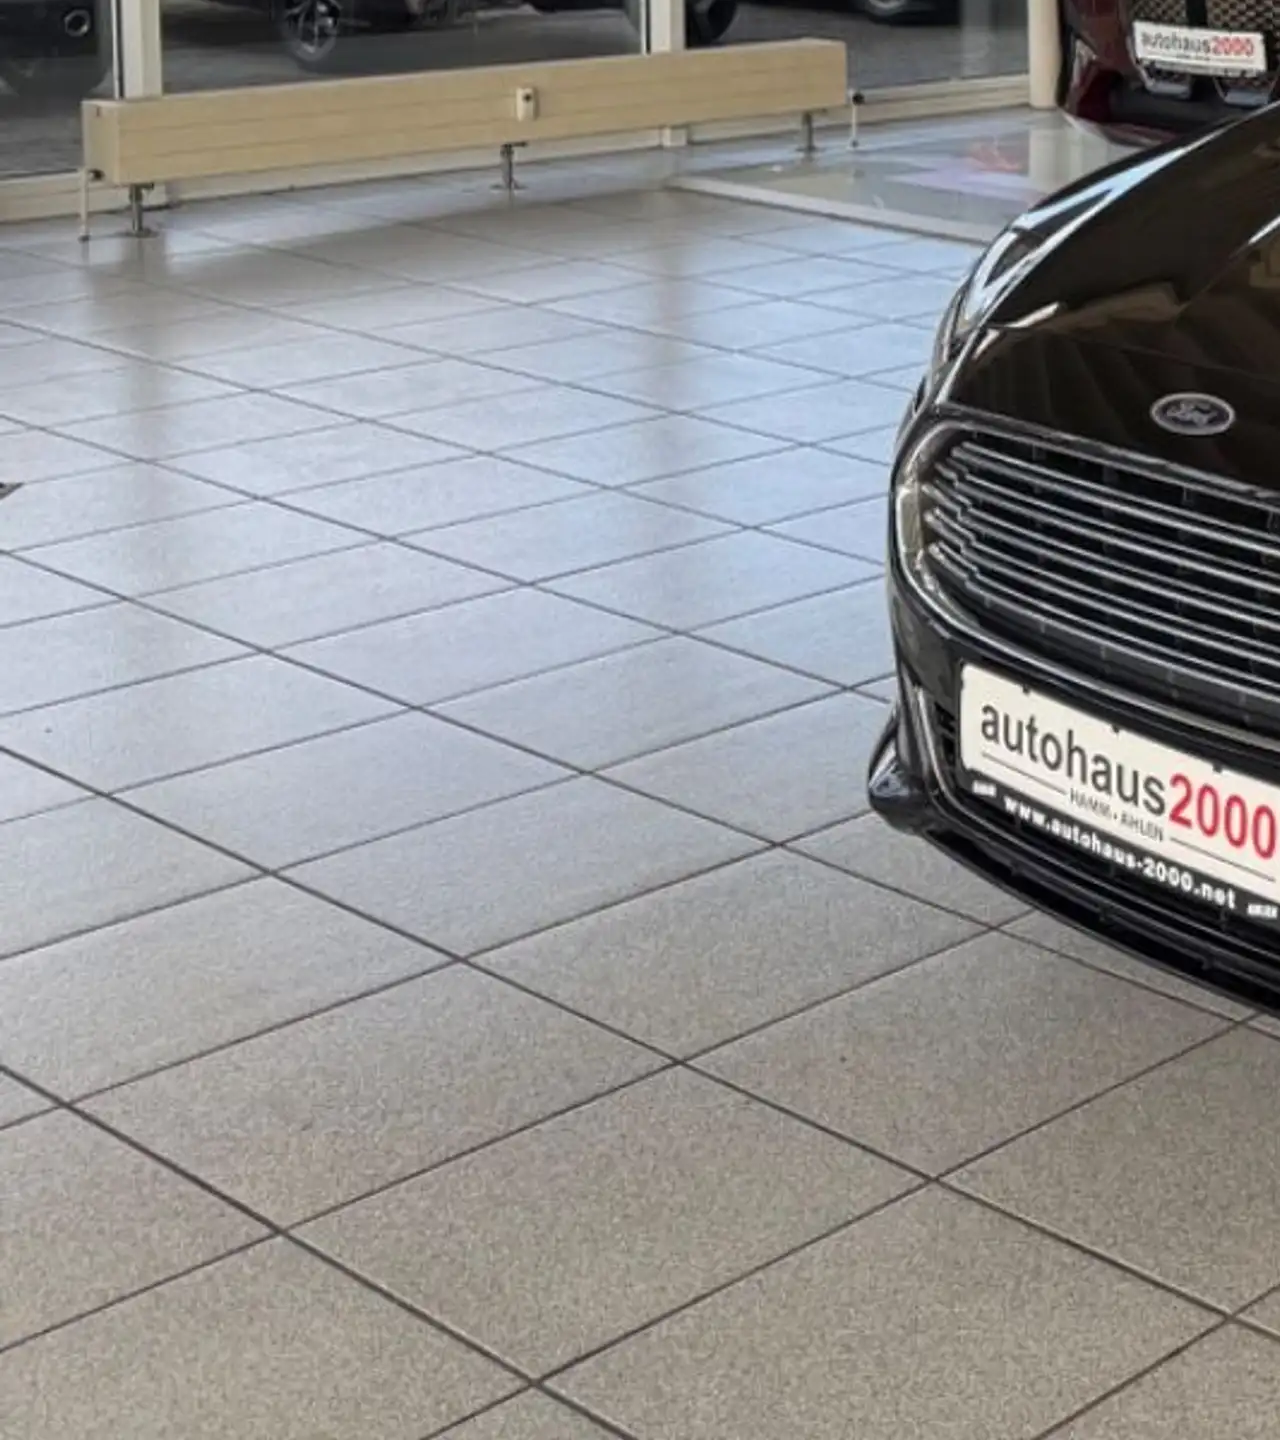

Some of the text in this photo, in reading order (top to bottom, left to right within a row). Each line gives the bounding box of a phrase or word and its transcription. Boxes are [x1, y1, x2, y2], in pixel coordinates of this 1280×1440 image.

[1141, 31, 1255, 57] autohaus2000
[980, 703, 1277, 860] autohaus2000
[1003, 794, 1237, 910] www.autohaus-2000.net
